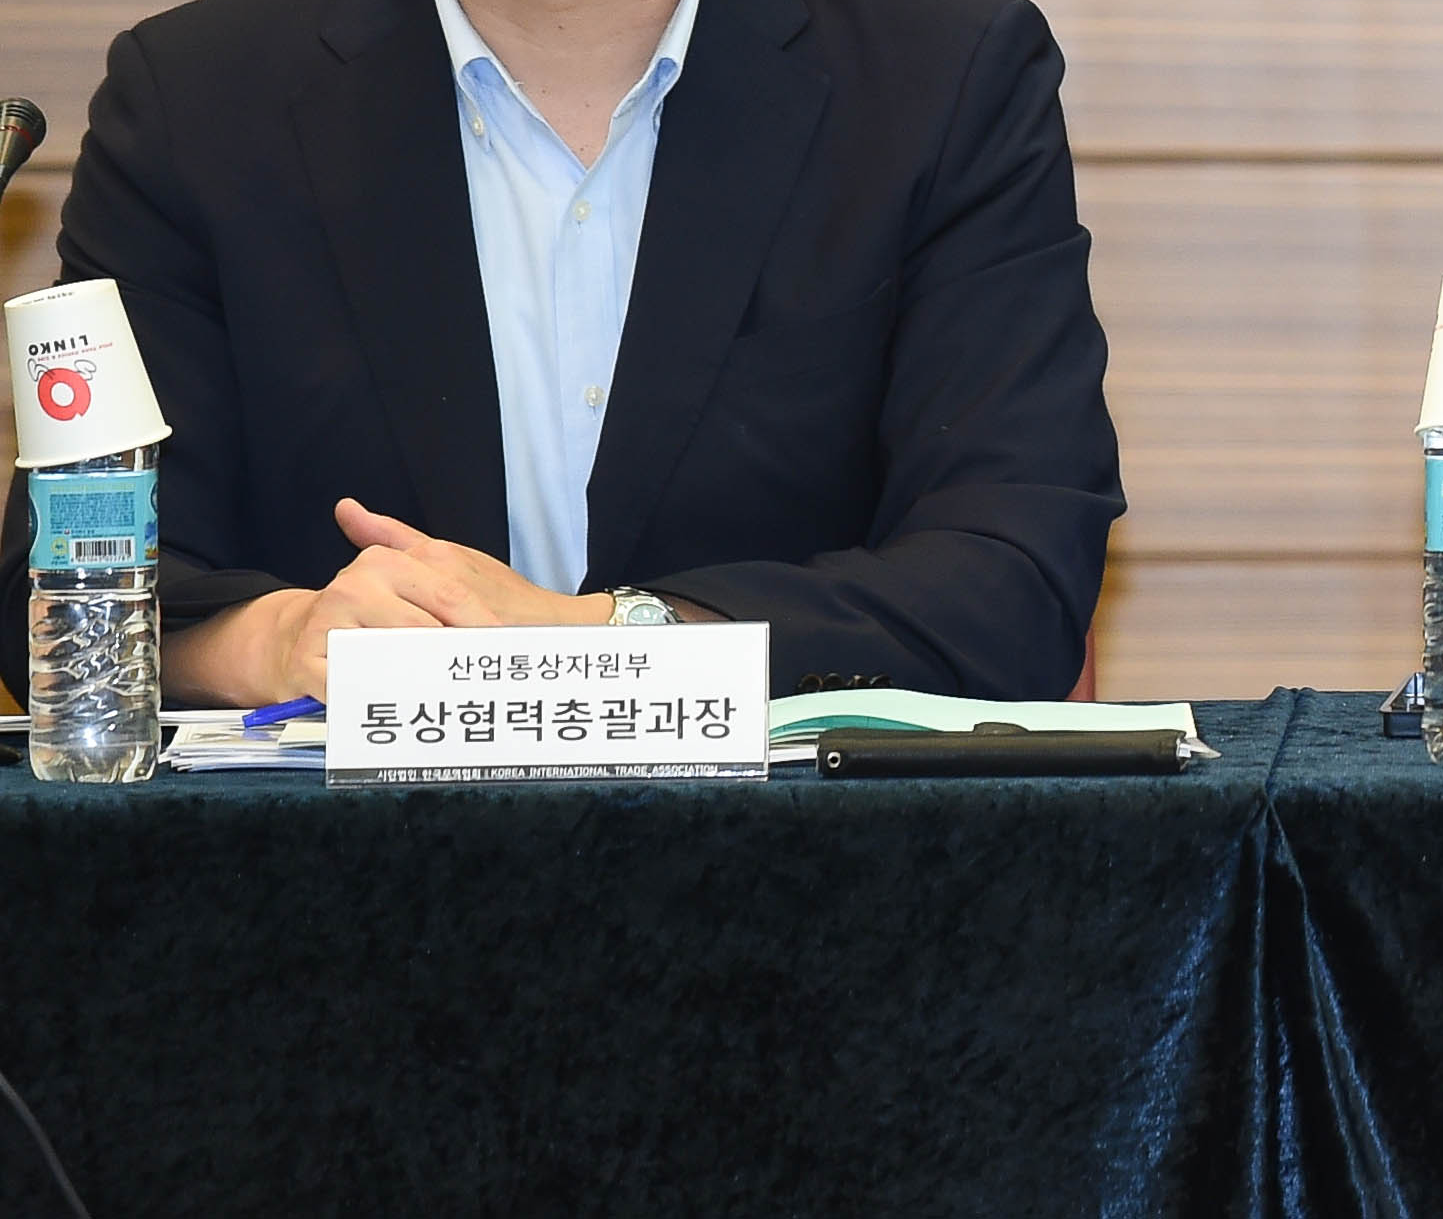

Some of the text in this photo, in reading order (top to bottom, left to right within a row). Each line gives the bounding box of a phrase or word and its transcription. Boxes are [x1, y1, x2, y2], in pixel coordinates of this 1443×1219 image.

[28, 334, 88, 357] LINKO
[448, 652, 652, 681] 산업통상자원부
[360, 697, 737, 745] 통상협력총괄과장
[490, 767, 525, 780] KOREA
[529, 765, 610, 779] INTERNATIONAL
[615, 765, 649, 777] TRADE
